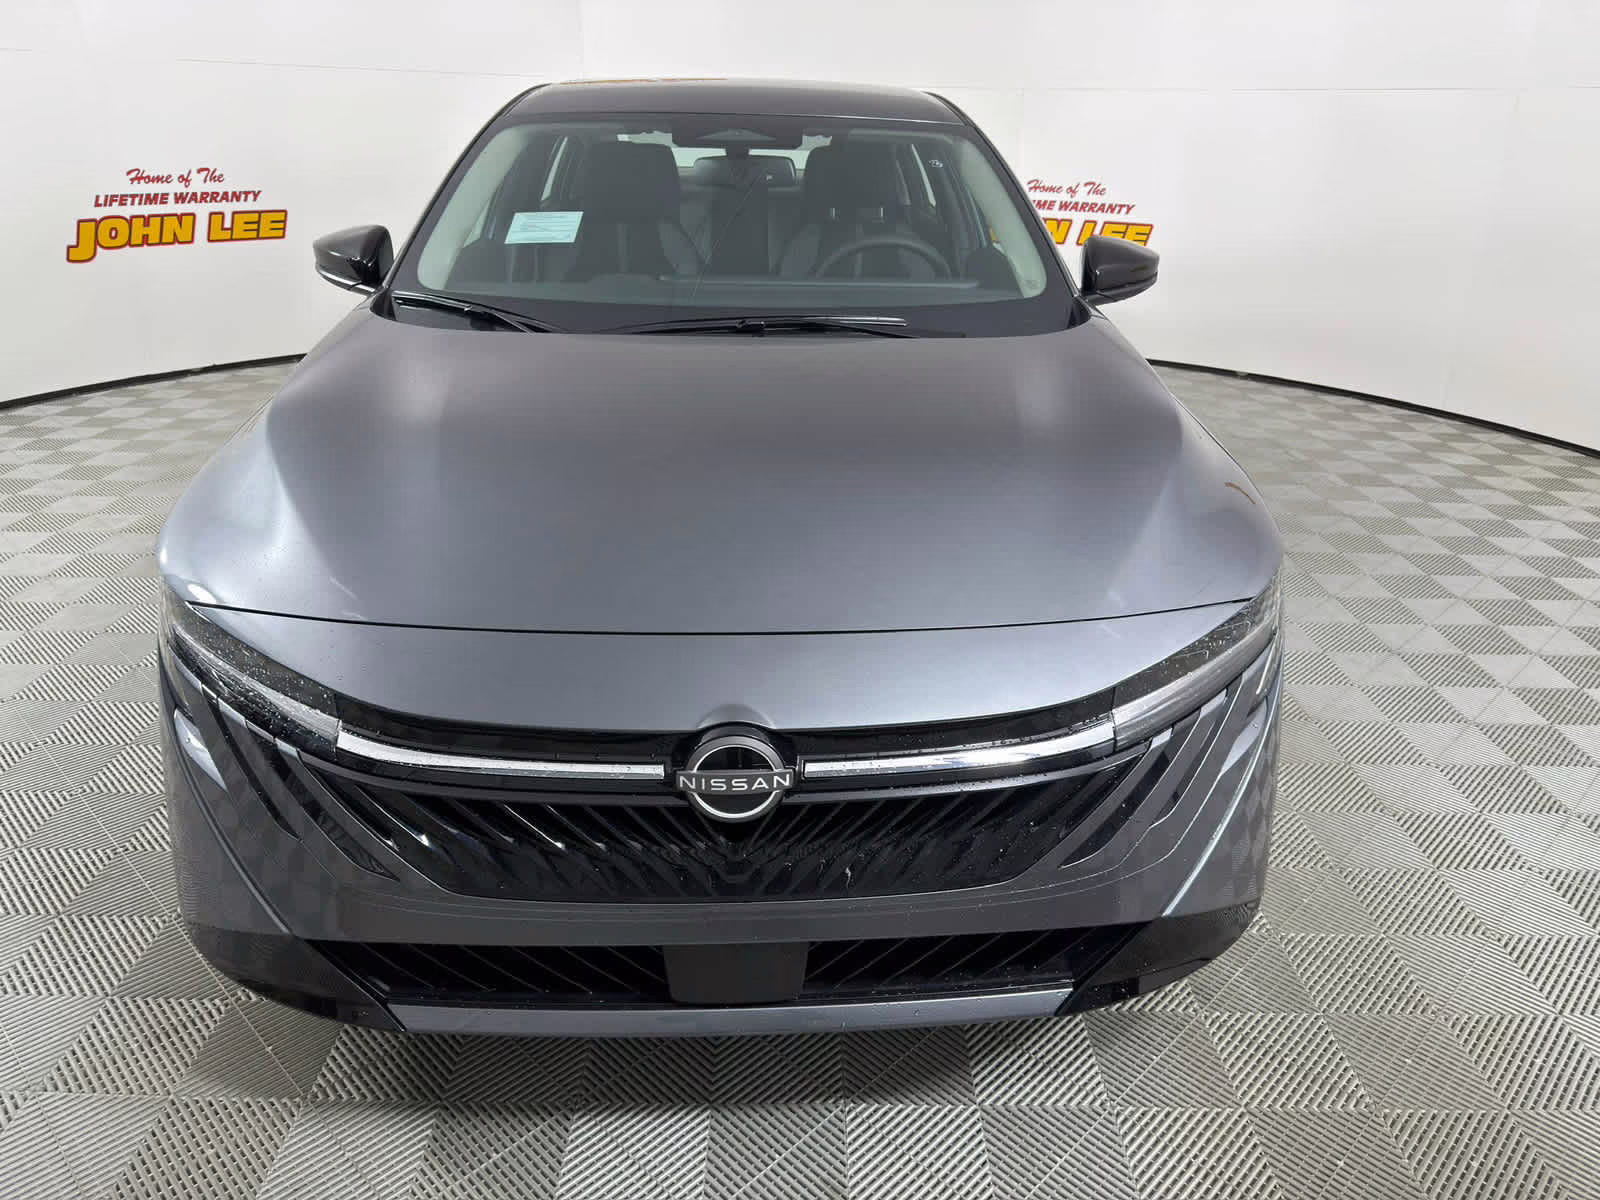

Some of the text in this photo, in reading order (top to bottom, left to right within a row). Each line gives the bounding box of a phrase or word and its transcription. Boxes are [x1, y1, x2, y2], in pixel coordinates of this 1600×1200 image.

[126, 167, 225, 188] Home of The
[1027, 179, 1107, 198] Home of The
[94, 190, 262, 207] LIFETIME WARRANTY
[1058, 200, 1135, 215] WARRANTY
[66, 209, 288, 263] JOHN LEE
[679, 773, 790, 791] NISSAN
